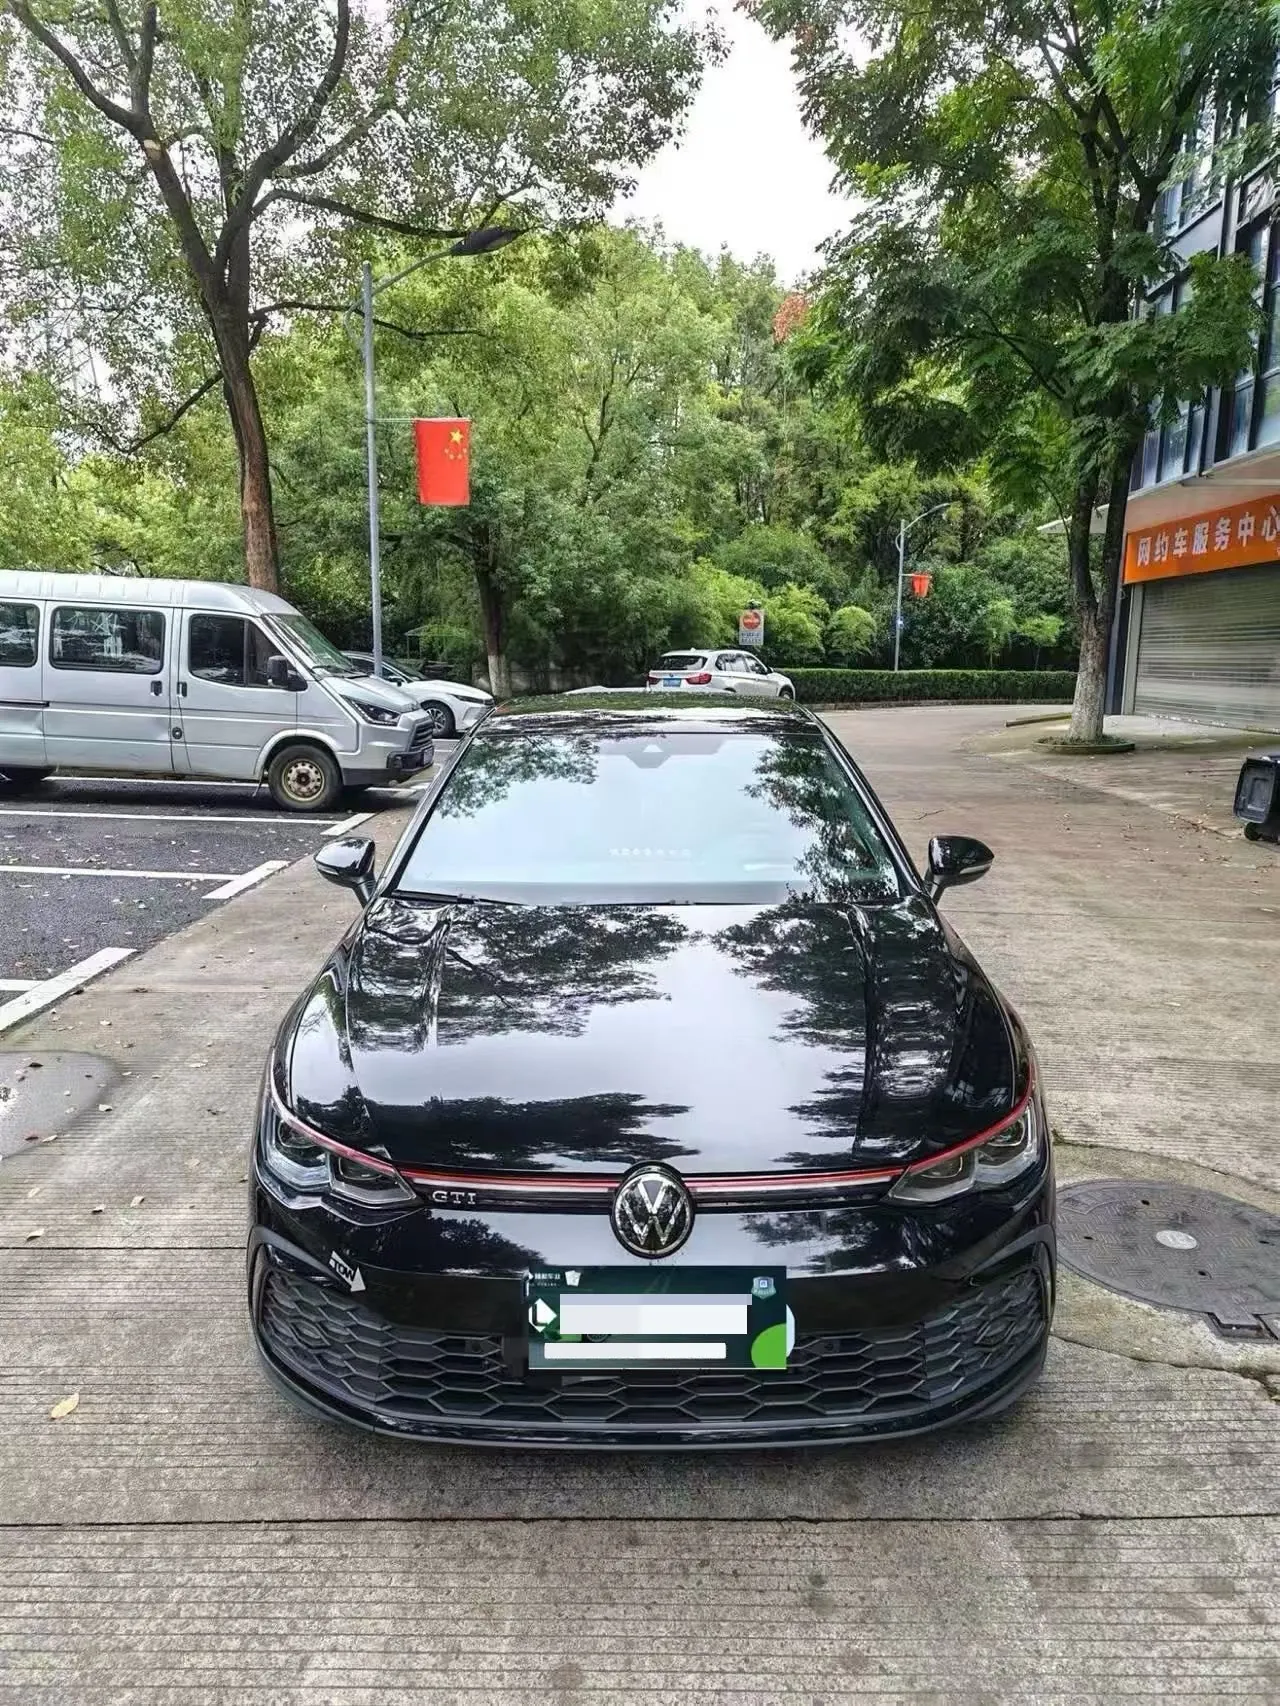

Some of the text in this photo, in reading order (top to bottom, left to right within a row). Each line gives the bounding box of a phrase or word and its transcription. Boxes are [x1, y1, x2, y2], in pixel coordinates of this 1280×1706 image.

[1137, 505, 1280, 566] 网约车服务中心
[432, 1190, 477, 1205] GTI
